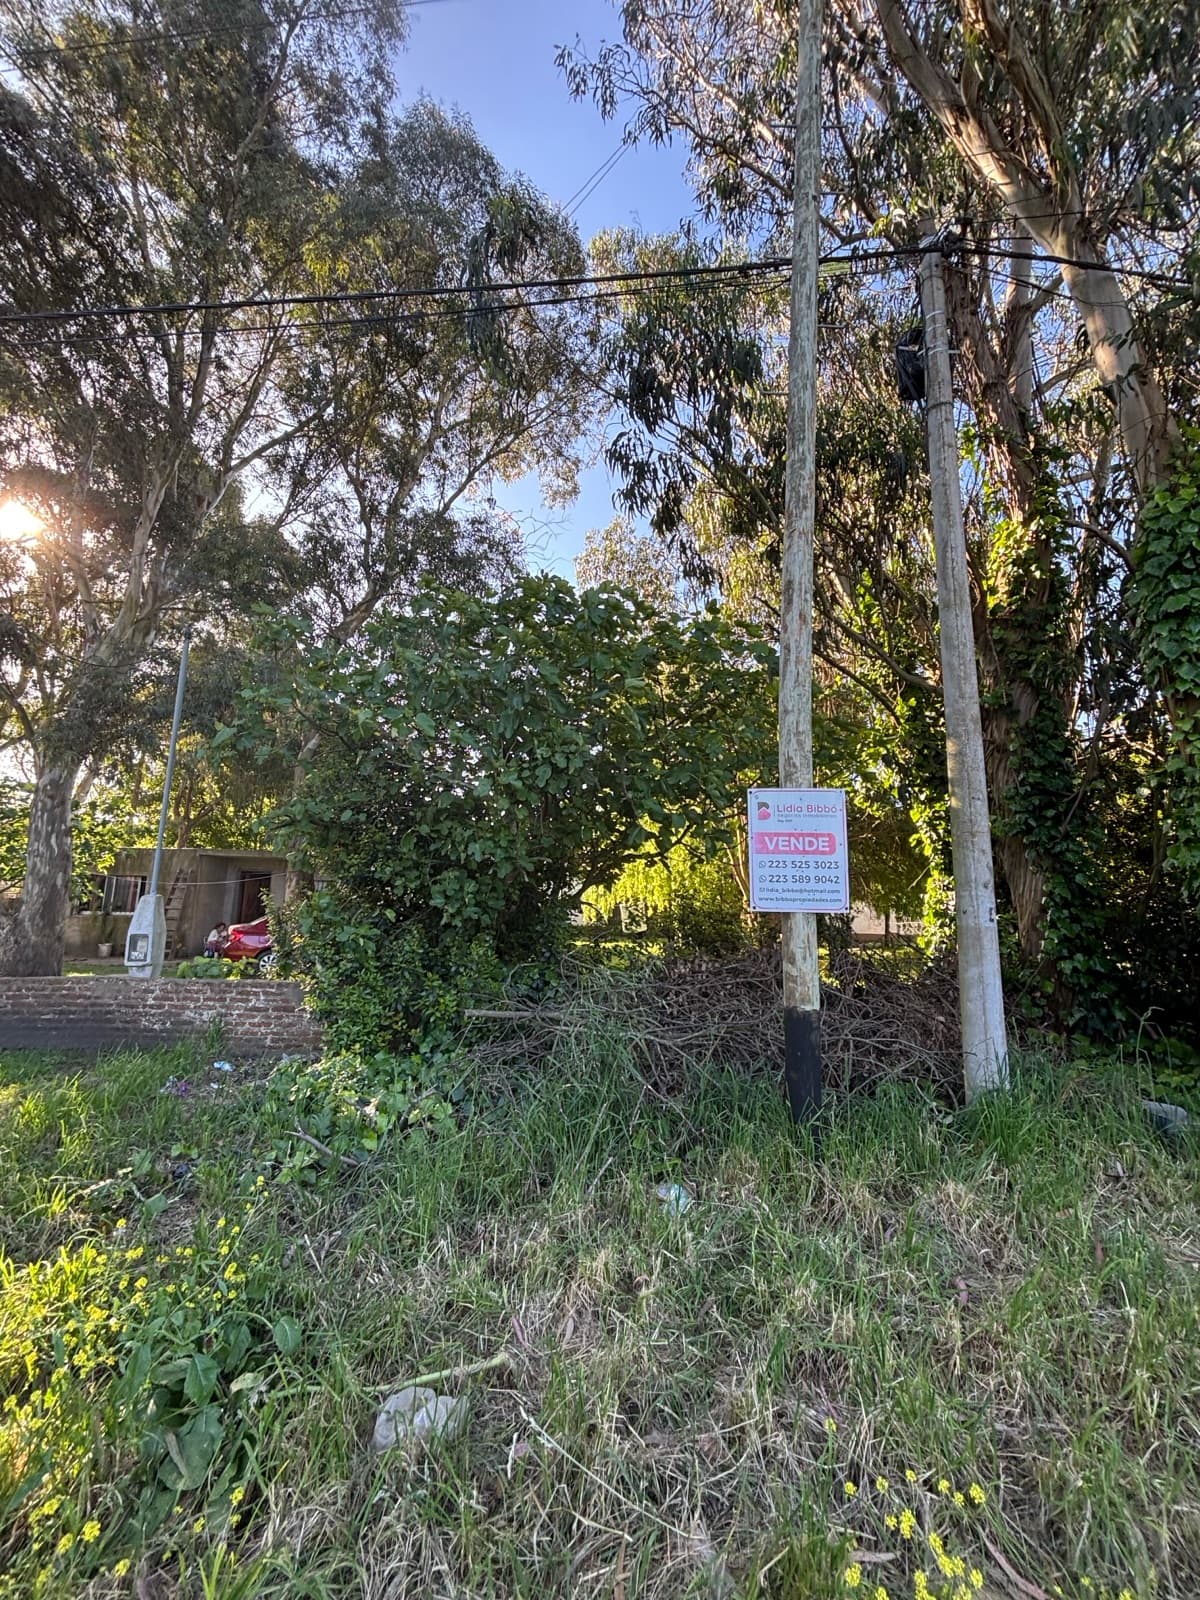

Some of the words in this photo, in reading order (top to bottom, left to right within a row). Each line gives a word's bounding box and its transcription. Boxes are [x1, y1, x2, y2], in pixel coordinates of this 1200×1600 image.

[776, 804, 803, 813] Lidia
[764, 836, 830, 851] VENDE
[768, 860, 788, 869] 223
[791, 860, 811, 869] 525
[813, 861, 840, 870] 3023
[768, 874, 788, 883] 223
[791, 874, 811, 884] 589
[814, 875, 840, 885] 9042
